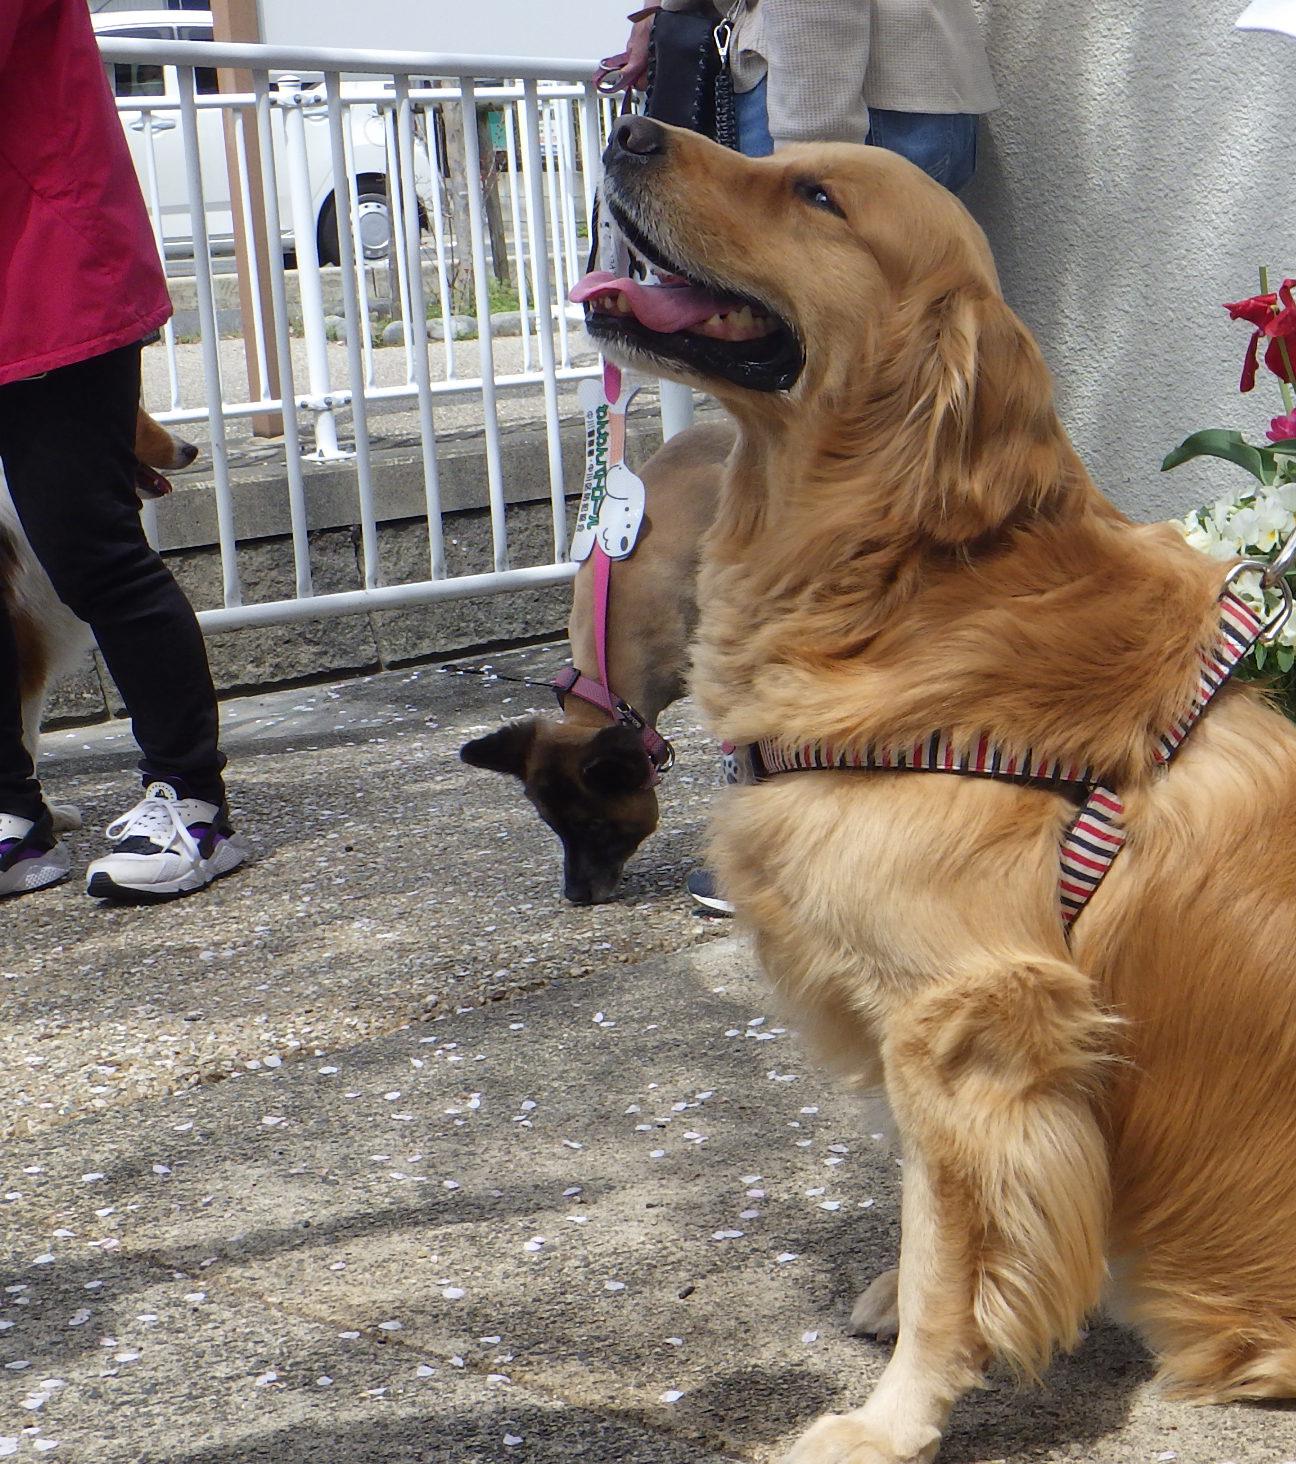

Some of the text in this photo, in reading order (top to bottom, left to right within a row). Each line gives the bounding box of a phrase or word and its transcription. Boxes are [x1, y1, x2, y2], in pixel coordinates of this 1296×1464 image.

[577, 410, 595, 532] 中川・中川区防犯会
